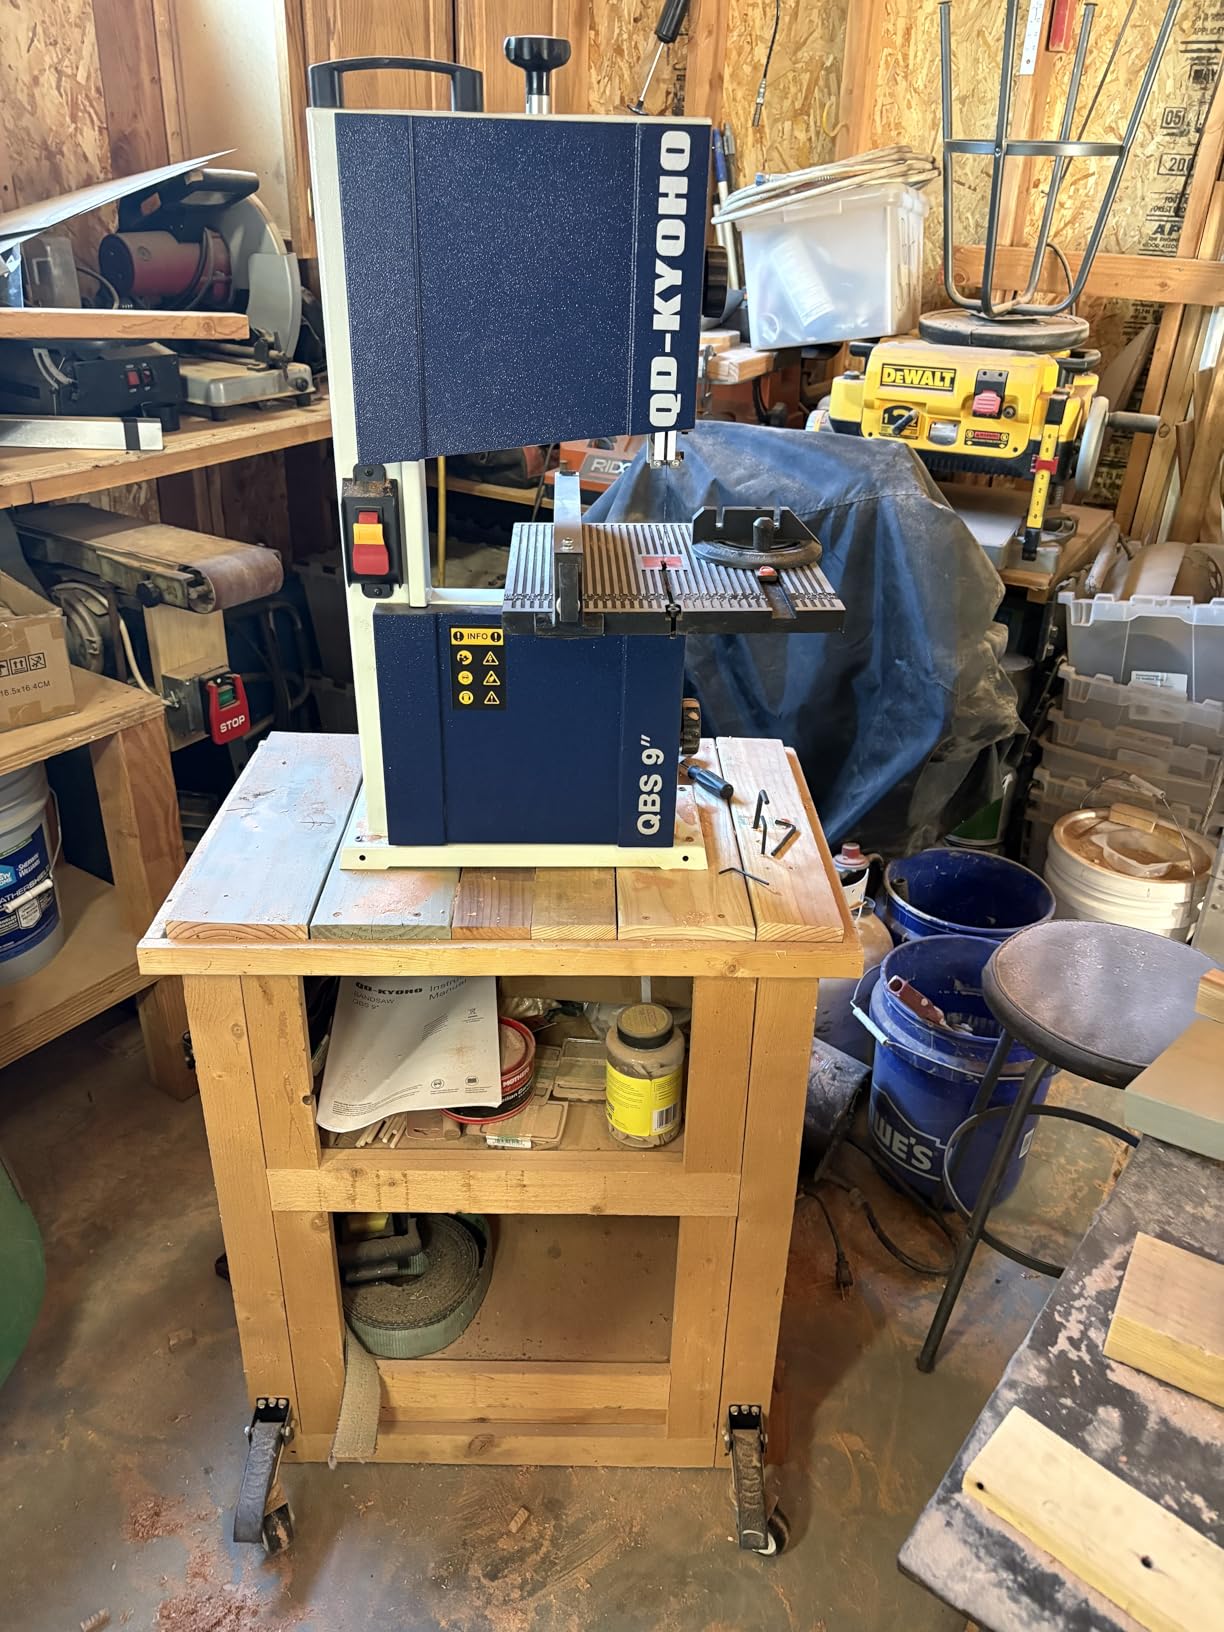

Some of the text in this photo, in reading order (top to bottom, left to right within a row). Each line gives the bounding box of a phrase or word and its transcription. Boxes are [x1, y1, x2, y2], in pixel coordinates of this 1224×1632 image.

[1152, 224, 1181, 236] AP
[649, 130, 691, 428] QD-KYOHO
[467, 632, 488, 641] INFO
[219, 714, 246, 733] STOP
[636, 774, 662, 836] QBS
[355, 981, 424, 995] QD-KYOHO
[353, 990, 395, 1005] BANDSAW
